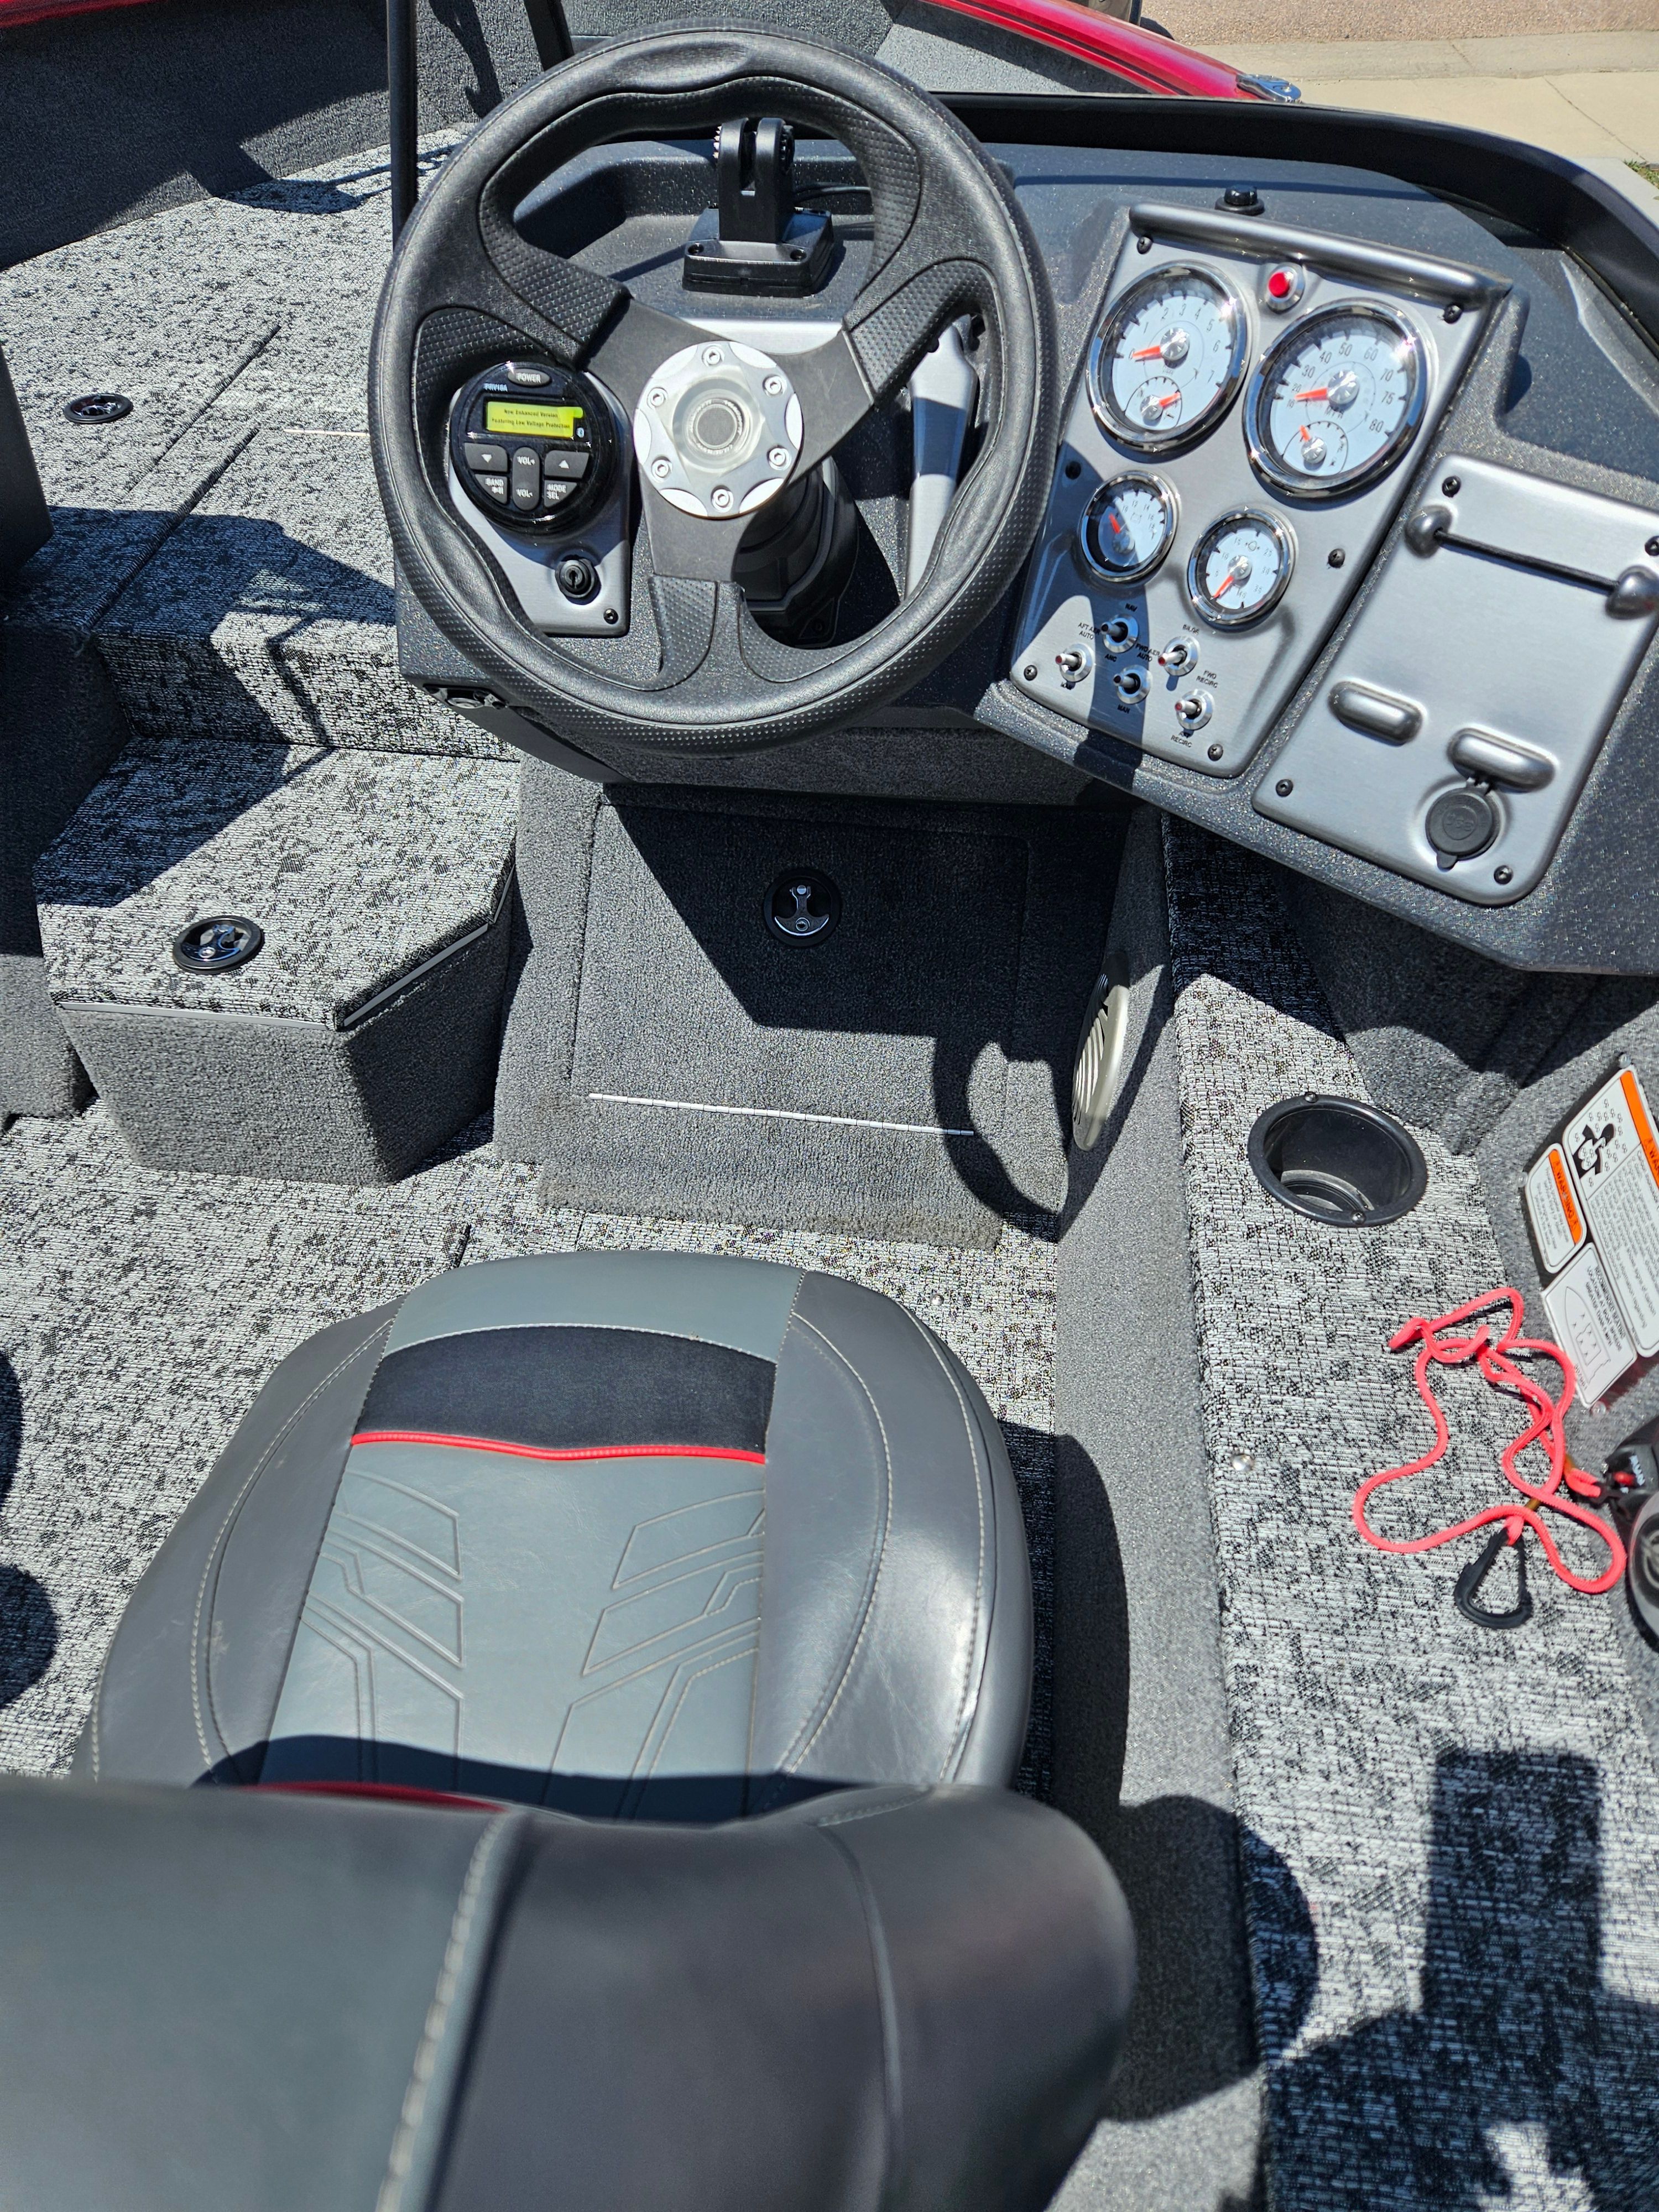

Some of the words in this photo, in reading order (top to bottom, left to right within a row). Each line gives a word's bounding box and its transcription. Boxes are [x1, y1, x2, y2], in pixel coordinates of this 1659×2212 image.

[1161, 307, 1168, 319] 2
[1179, 304, 1186, 316] 3
[1195, 307, 1201, 320] 4
[1143, 322, 1149, 333] 1
[1207, 319, 1214, 331] 5
[1213, 340, 1220, 353] 6
[1338, 342, 1353, 357] 50
[1319, 351, 1332, 364] 40
[1364, 347, 1379, 361] 60
[1208, 370, 1214, 383] 7
[1301, 364, 1316, 378] 30
[1380, 368, 1394, 382] 70
[516, 373, 541, 383] POWER
[1381, 391, 1395, 405] 75
[1369, 419, 1384, 433] 80
[517, 456, 535, 466] VOL+
[485, 478, 504, 487] BAND
[547, 484, 566, 493] MODE
[1125, 603, 1138, 612] NAV
[1079, 630, 1094, 640] AUTO
[1135, 643, 1149, 653] FWD
[1104, 654, 1117, 662] ANC
[1137, 653, 1152, 662] AUTO
[1203, 670, 1217, 679] FWD
[1196, 676, 1218, 688] RECIRC
[1117, 705, 1130, 713] MAN
[1171, 735, 1192, 748] RECIRC
[1593, 1265, 1615, 1313] RECOMMENDED
